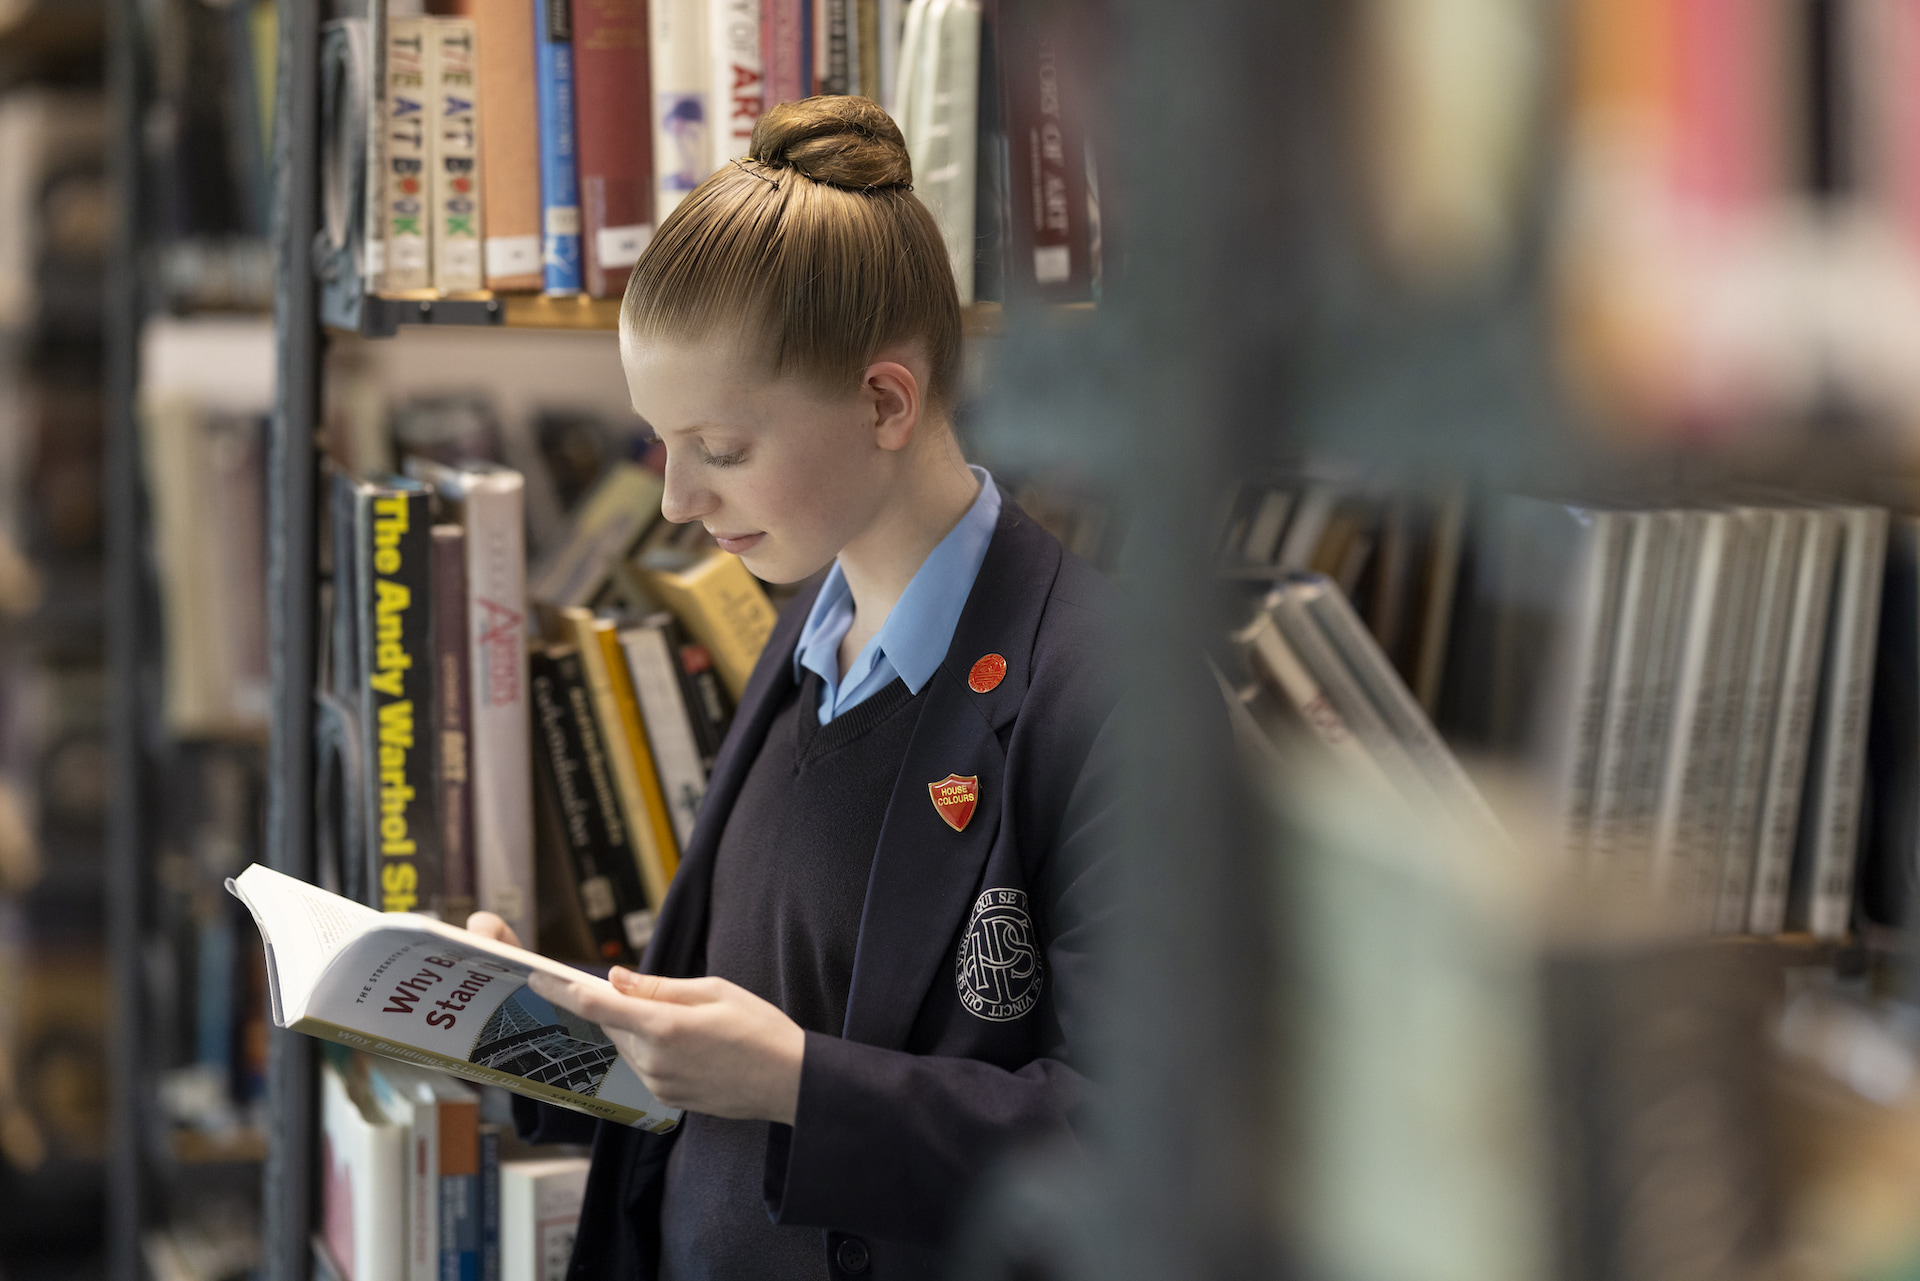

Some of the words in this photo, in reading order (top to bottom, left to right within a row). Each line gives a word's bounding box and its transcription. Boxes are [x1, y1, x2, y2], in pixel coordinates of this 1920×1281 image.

[391, 157, 423, 237] BOOK
[444, 157, 475, 237] BOOK
[373, 492, 410, 577] The
[370, 580, 413, 696] Andy
[376, 700, 418, 858] Warhol
[937, 793, 975, 808] COLOURS
[941, 785, 968, 797] HOUSE
[975, 893, 993, 913] QUI
[998, 892, 1017, 905] SE
[356, 985, 372, 1004] THE
[382, 967, 443, 1014] Why
[426, 970, 495, 1030] Stand
[963, 990, 984, 1012] QUI
[988, 994, 1034, 1018] VINCIT
[337, 1029, 371, 1048] Why
[374, 1041, 446, 1070] Buildings
[447, 1060, 497, 1084] Stand
[496, 1075, 522, 1090] Up
[549, 1092, 618, 1117] SALVADORI
